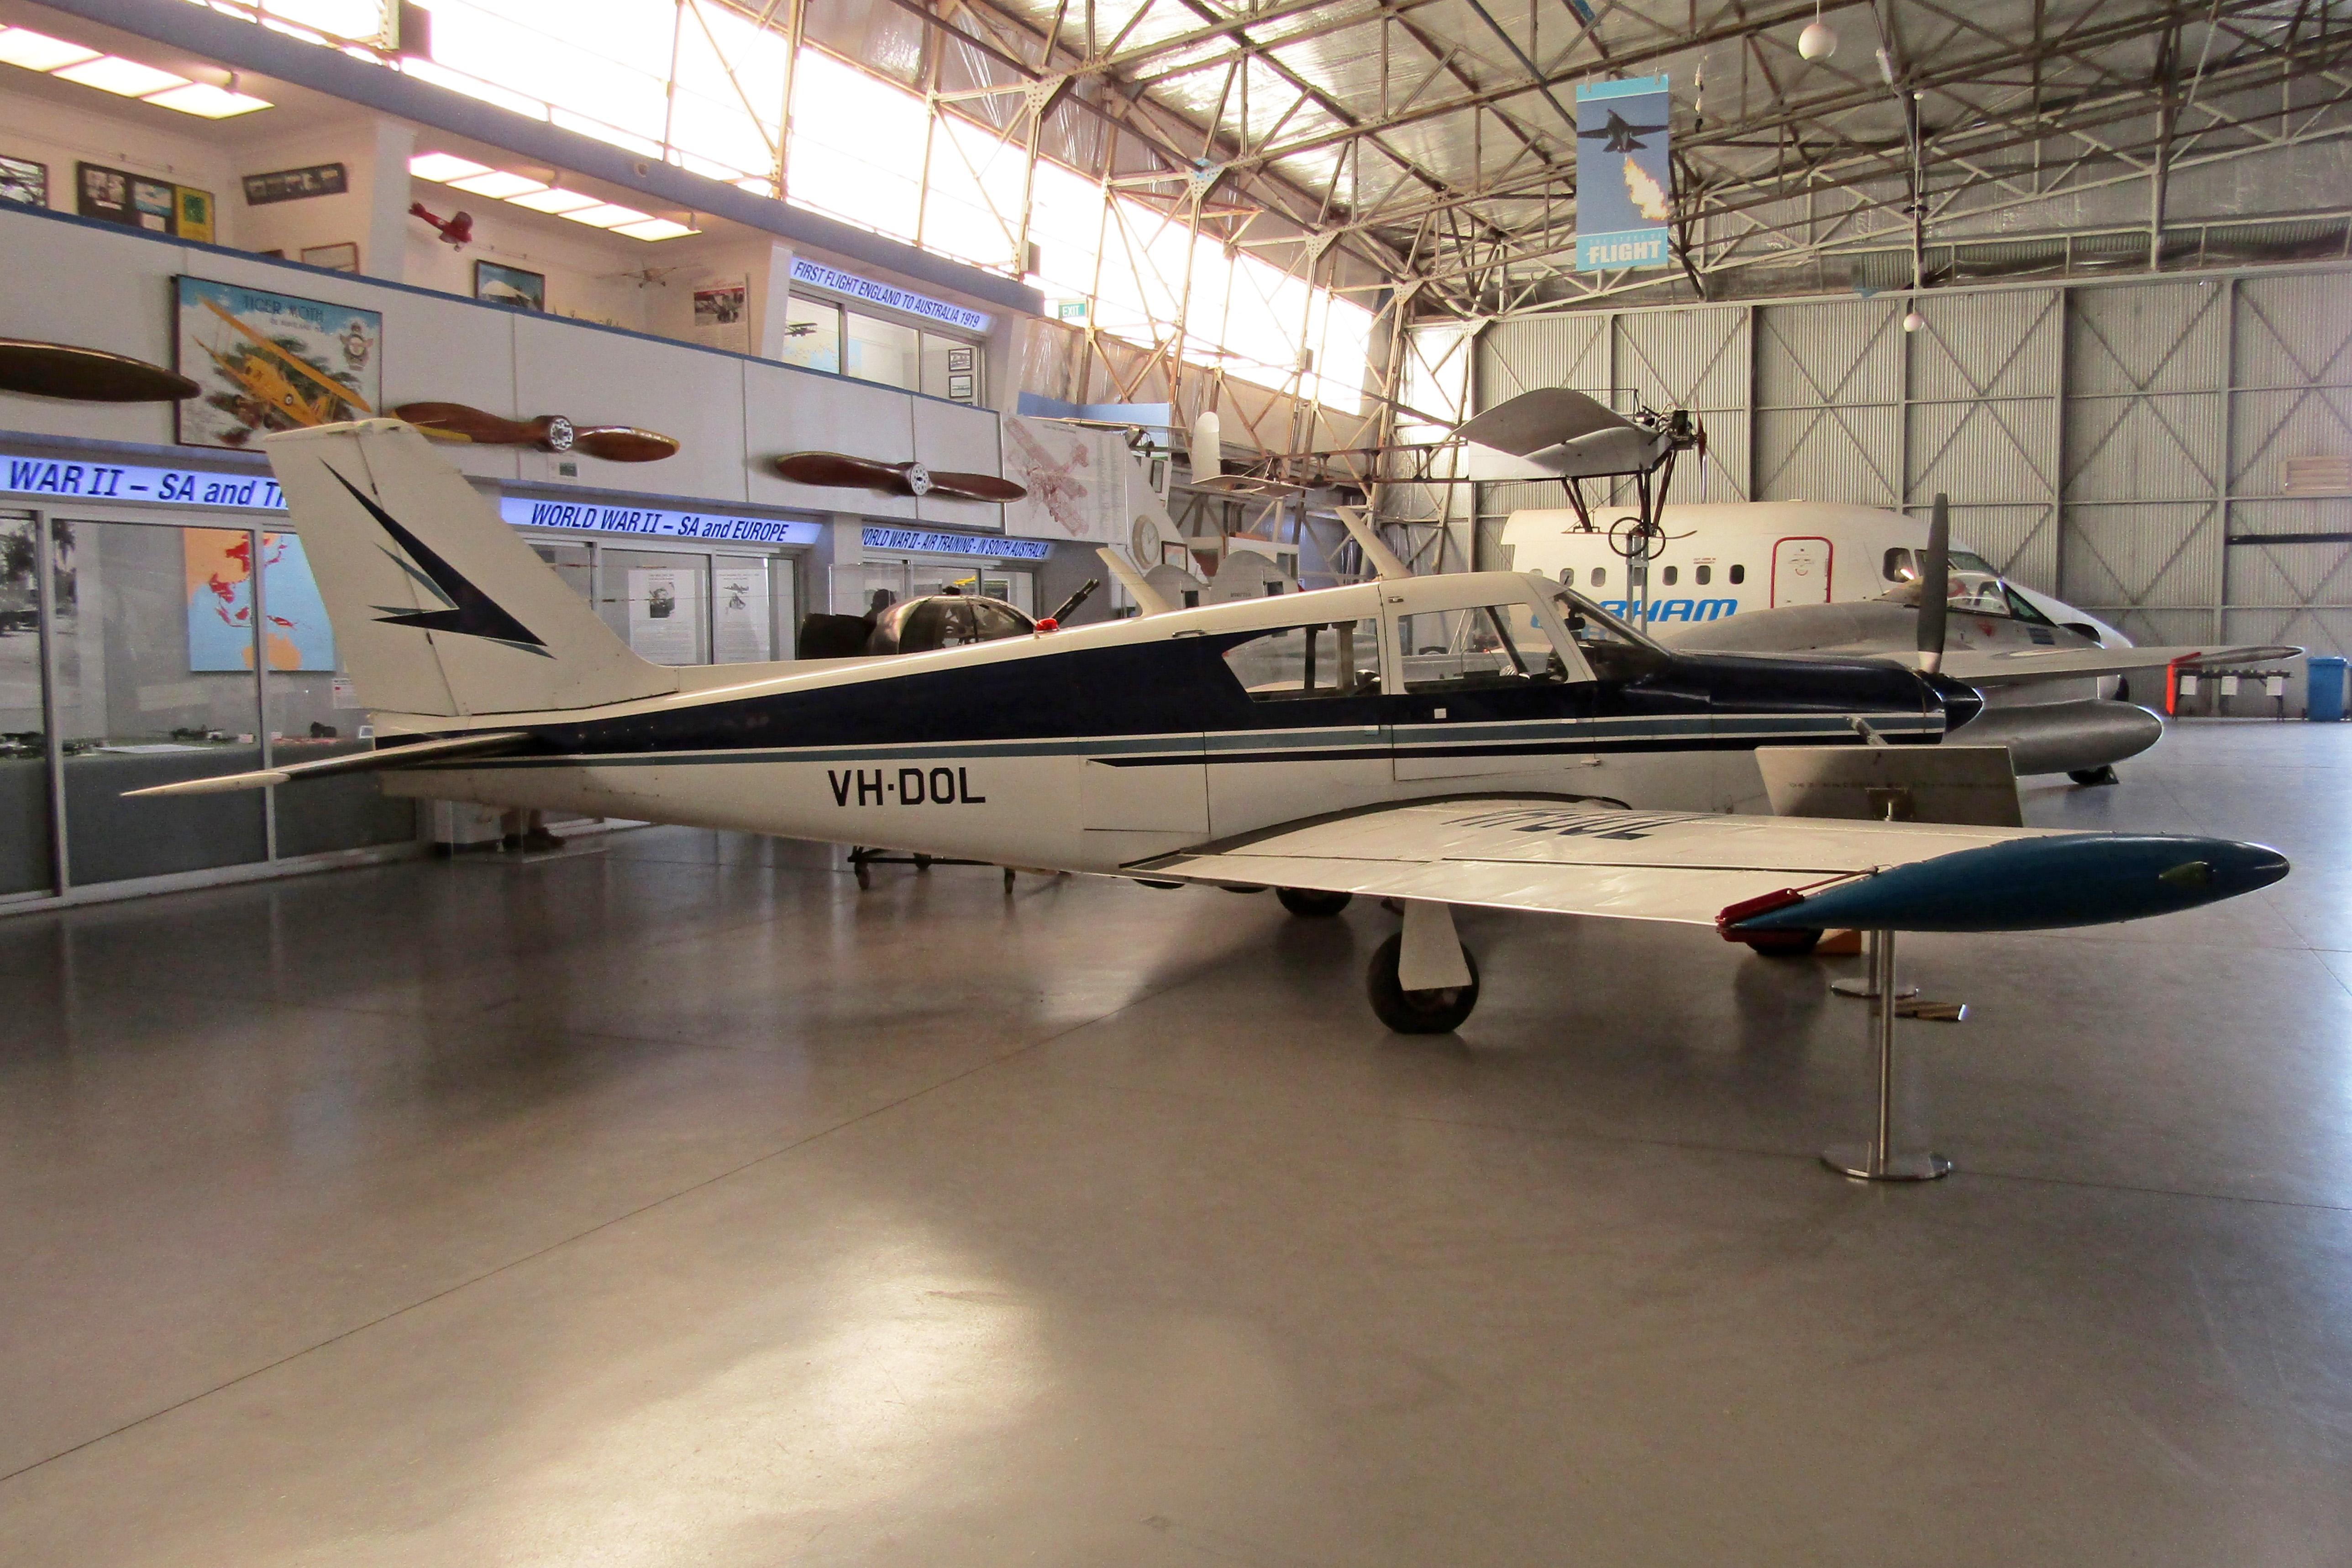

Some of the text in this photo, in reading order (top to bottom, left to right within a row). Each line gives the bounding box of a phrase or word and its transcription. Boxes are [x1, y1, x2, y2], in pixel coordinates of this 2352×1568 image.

[1586, 240, 1662, 264] FLIGHT
[794, 262, 980, 328] FIRST FLIGHT ENGLAND TO AUSTRALIA 1919
[1062, 305, 1080, 316] EXIT
[10, 461, 85, 493] WAR
[88, 467, 125, 496] II
[158, 473, 196, 501] SA
[204, 480, 257, 505] and
[531, 503, 598, 528] WORLD
[600, 509, 641, 532] WAR
[640, 513, 662, 533] II
[677, 516, 700, 536] SA
[702, 520, 732, 538] and
[732, 520, 789, 541] EUROPE
[889, 530, 911, 548] WAR
[908, 533, 920, 549] II
[920, 534, 938, 550] AIR
[936, 535, 974, 554] TRAINING
[976, 539, 988, 554] IN
[986, 539, 1011, 556] SOUTH
[1010, 541, 1049, 559] AUSTRALIA
